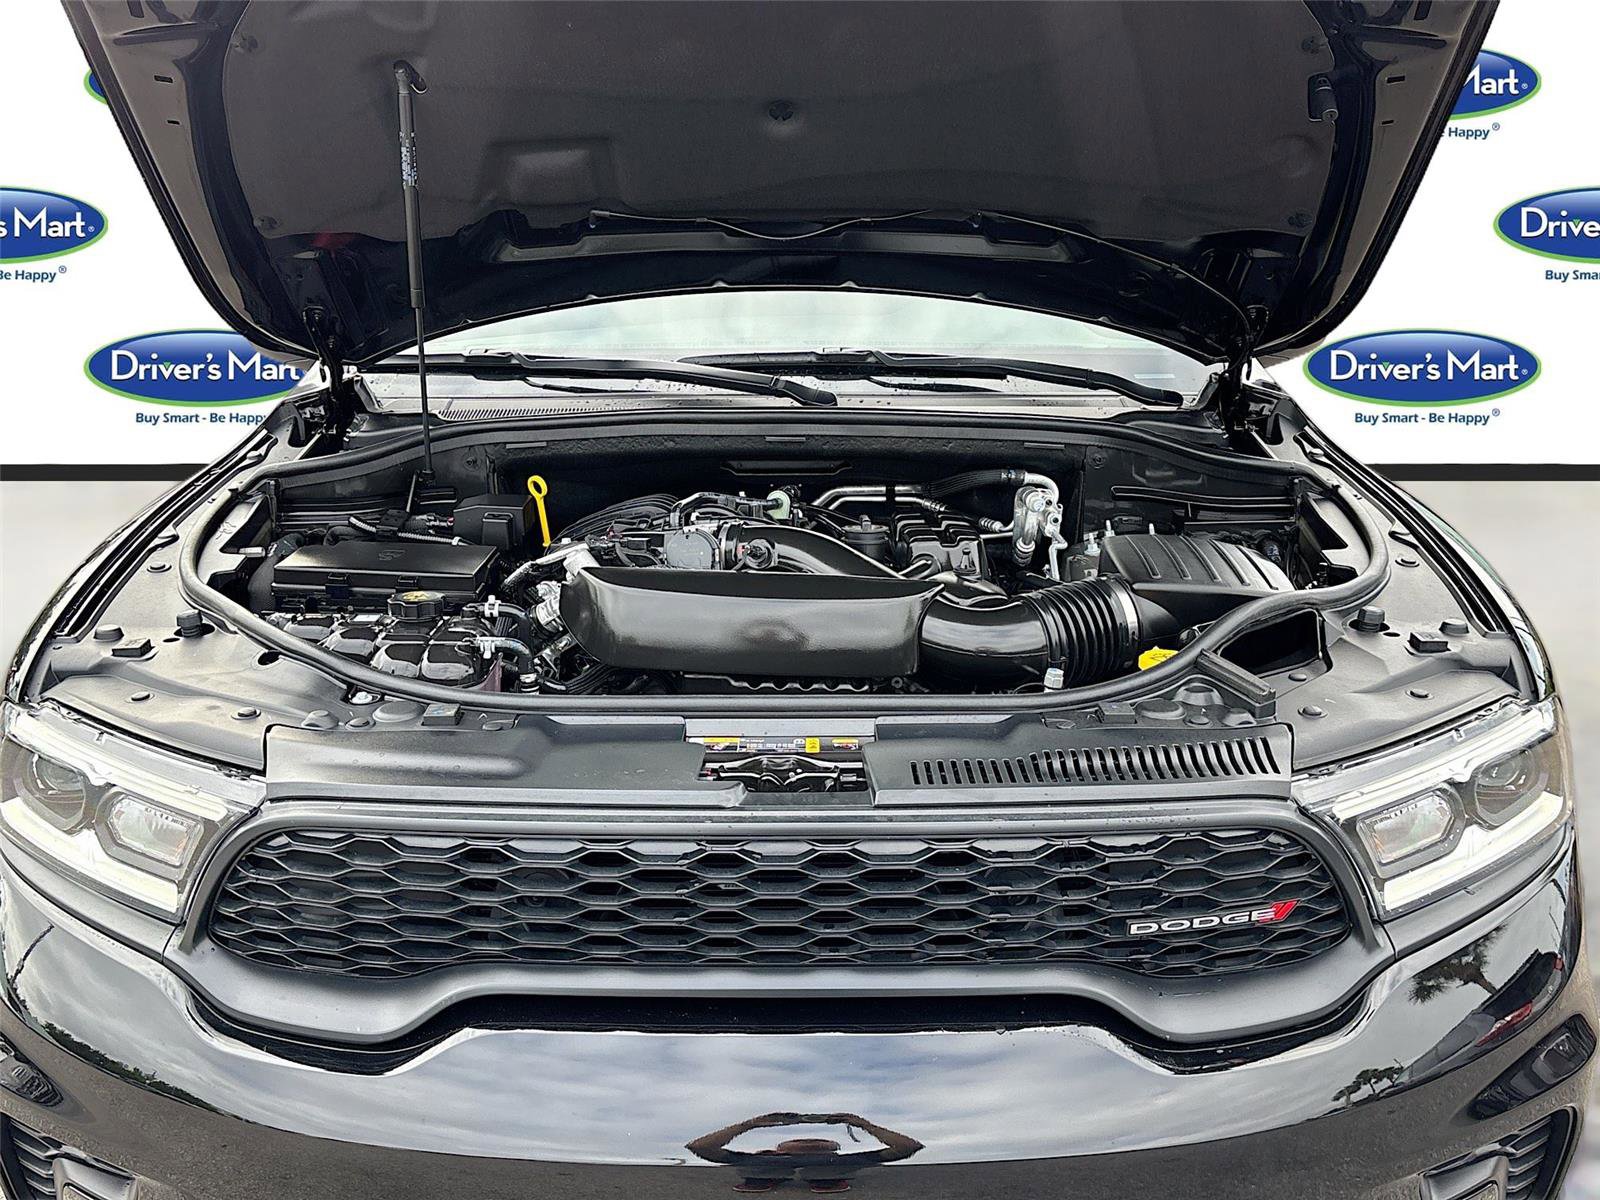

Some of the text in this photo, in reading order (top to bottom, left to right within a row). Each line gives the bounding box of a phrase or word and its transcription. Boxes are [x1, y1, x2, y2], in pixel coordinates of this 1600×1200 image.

[1448, 127, 1490, 140] Happy
[14, 207, 86, 238] Mart
[15, 270, 57, 283] Happy
[1545, 270, 1600, 283] Buy Sma
[111, 350, 222, 380] Driver's
[1330, 349, 1519, 380] Driver's Mart
[135, 412, 160, 425] Buy
[163, 412, 200, 423] Smart
[209, 412, 226, 423] Be
[229, 412, 266, 425] Happ
[1354, 412, 1379, 426] Buy
[1382, 412, 1419, 423] Smart
[1429, 412, 1445, 423] Be
[1448, 412, 1490, 426] Happy
[1129, 907, 1276, 935] DODGE
